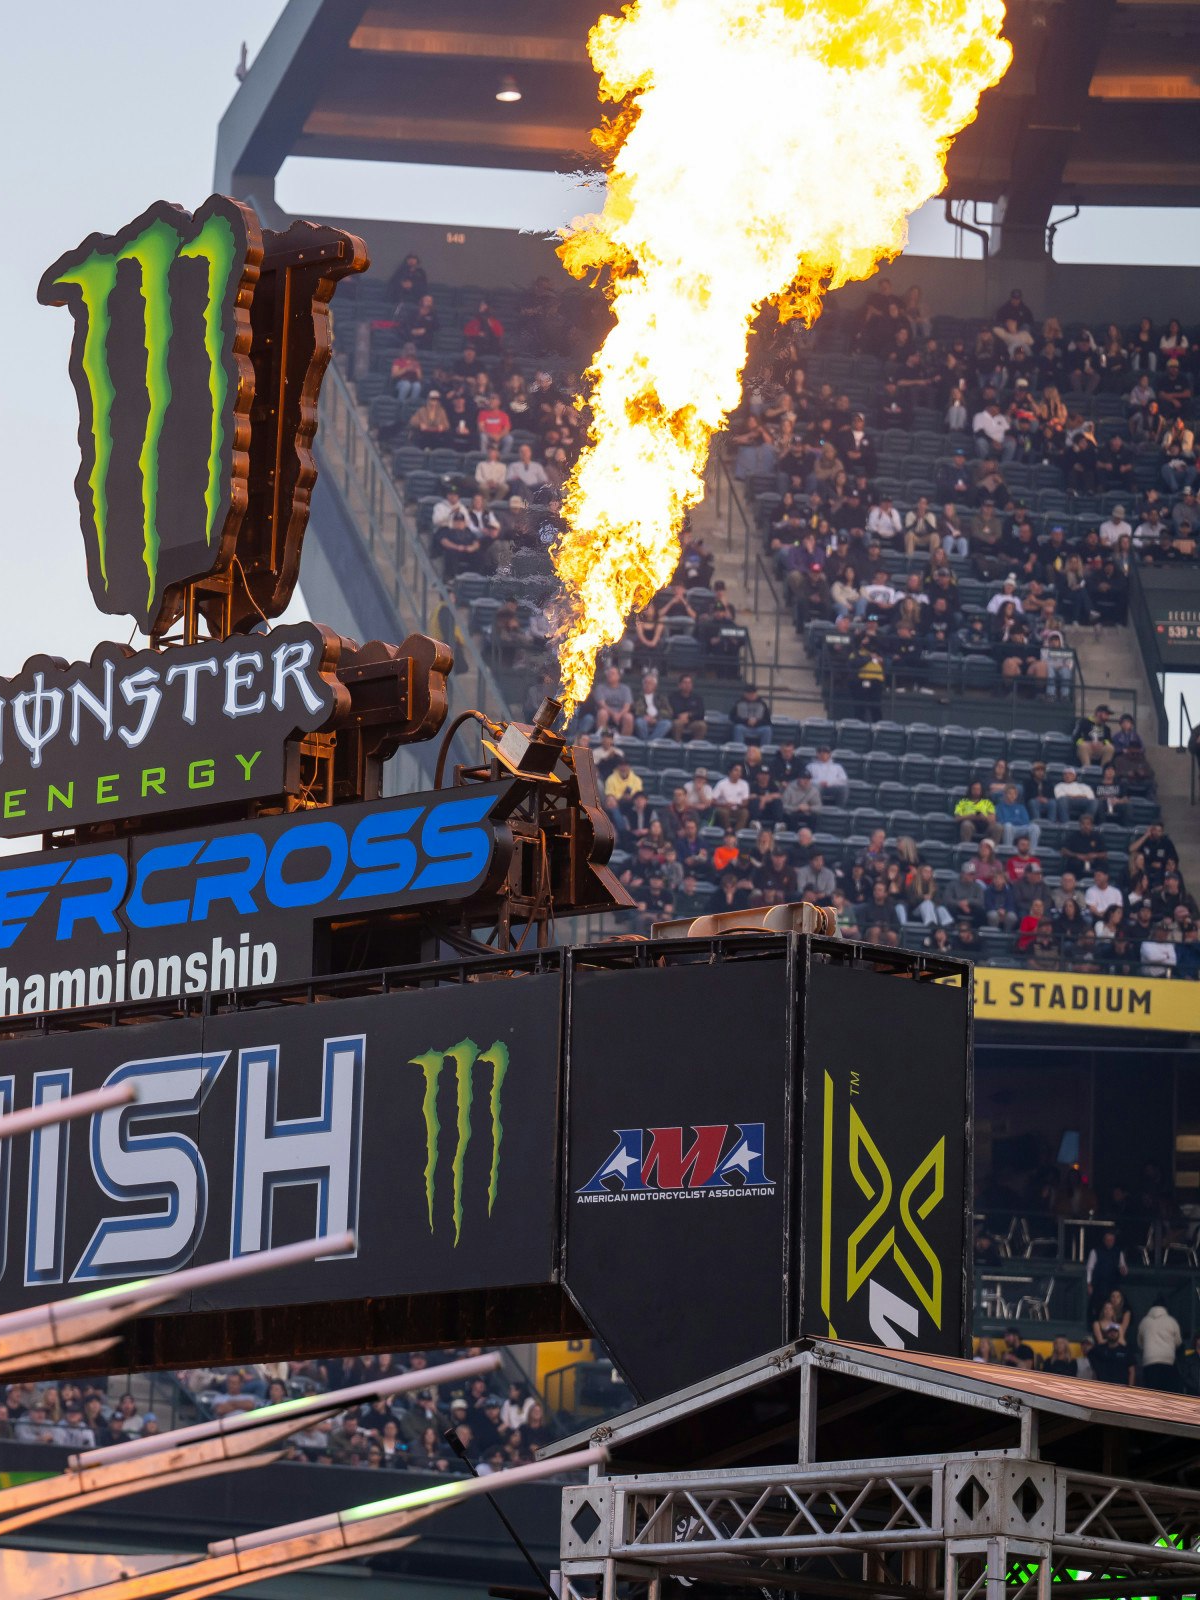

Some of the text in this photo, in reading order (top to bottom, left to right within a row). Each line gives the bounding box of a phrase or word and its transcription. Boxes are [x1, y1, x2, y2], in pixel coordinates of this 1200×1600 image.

[3, 750, 263, 819] ENERGY
[1009, 981, 1153, 1015] STADIUM
[574, 1122, 777, 1193] AMA
[577, 1187, 775, 1204] AMERICAN MOTORCYCLIST ASSOCIATION
